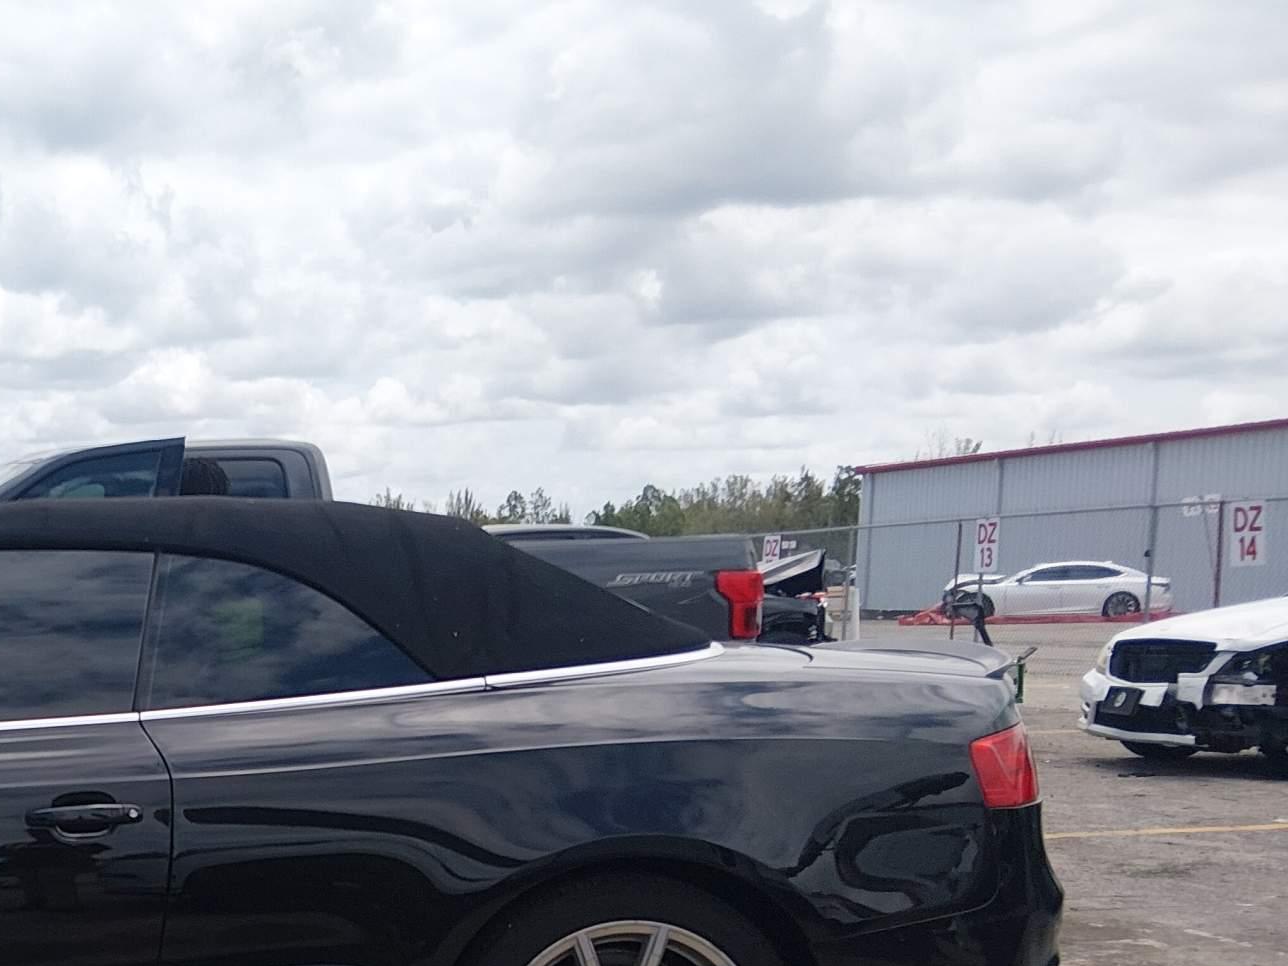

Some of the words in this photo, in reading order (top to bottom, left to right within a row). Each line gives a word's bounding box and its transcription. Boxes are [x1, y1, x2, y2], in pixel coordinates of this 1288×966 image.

[1234, 505, 1263, 533] DZ
[977, 522, 998, 545] DZ
[980, 547, 993, 568] 13
[1239, 535, 1257, 561] 14
